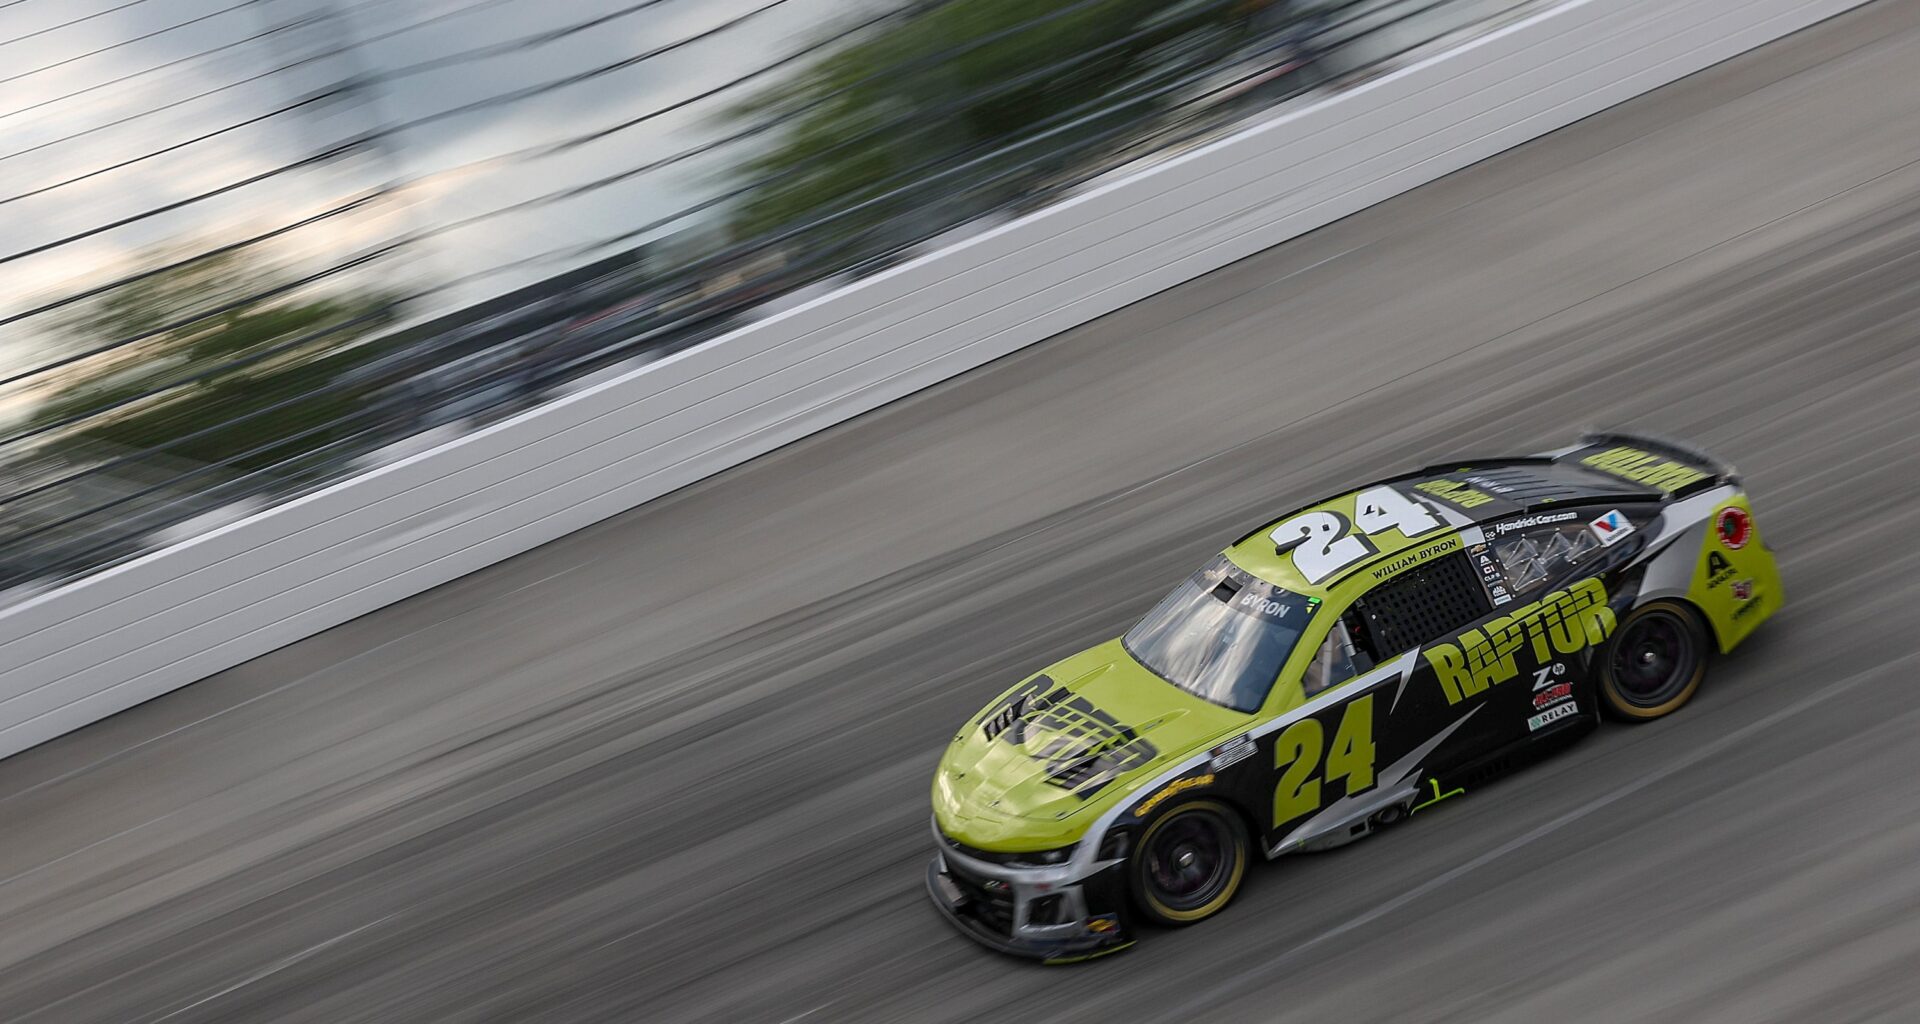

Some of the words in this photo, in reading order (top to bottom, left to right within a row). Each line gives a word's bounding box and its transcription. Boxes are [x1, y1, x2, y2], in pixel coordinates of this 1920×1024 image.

[1269, 484, 1442, 585] 24
[1496, 512, 1578, 535] HendrickCars.com
[1372, 554, 1418, 579] WILLIAM
[1419, 539, 1457, 559] BYRON
[1240, 593, 1291, 618] BYRON
[1422, 577, 1618, 706] RAPTOR
[1541, 703, 1575, 723] RELAY
[1272, 692, 1377, 830] 24
